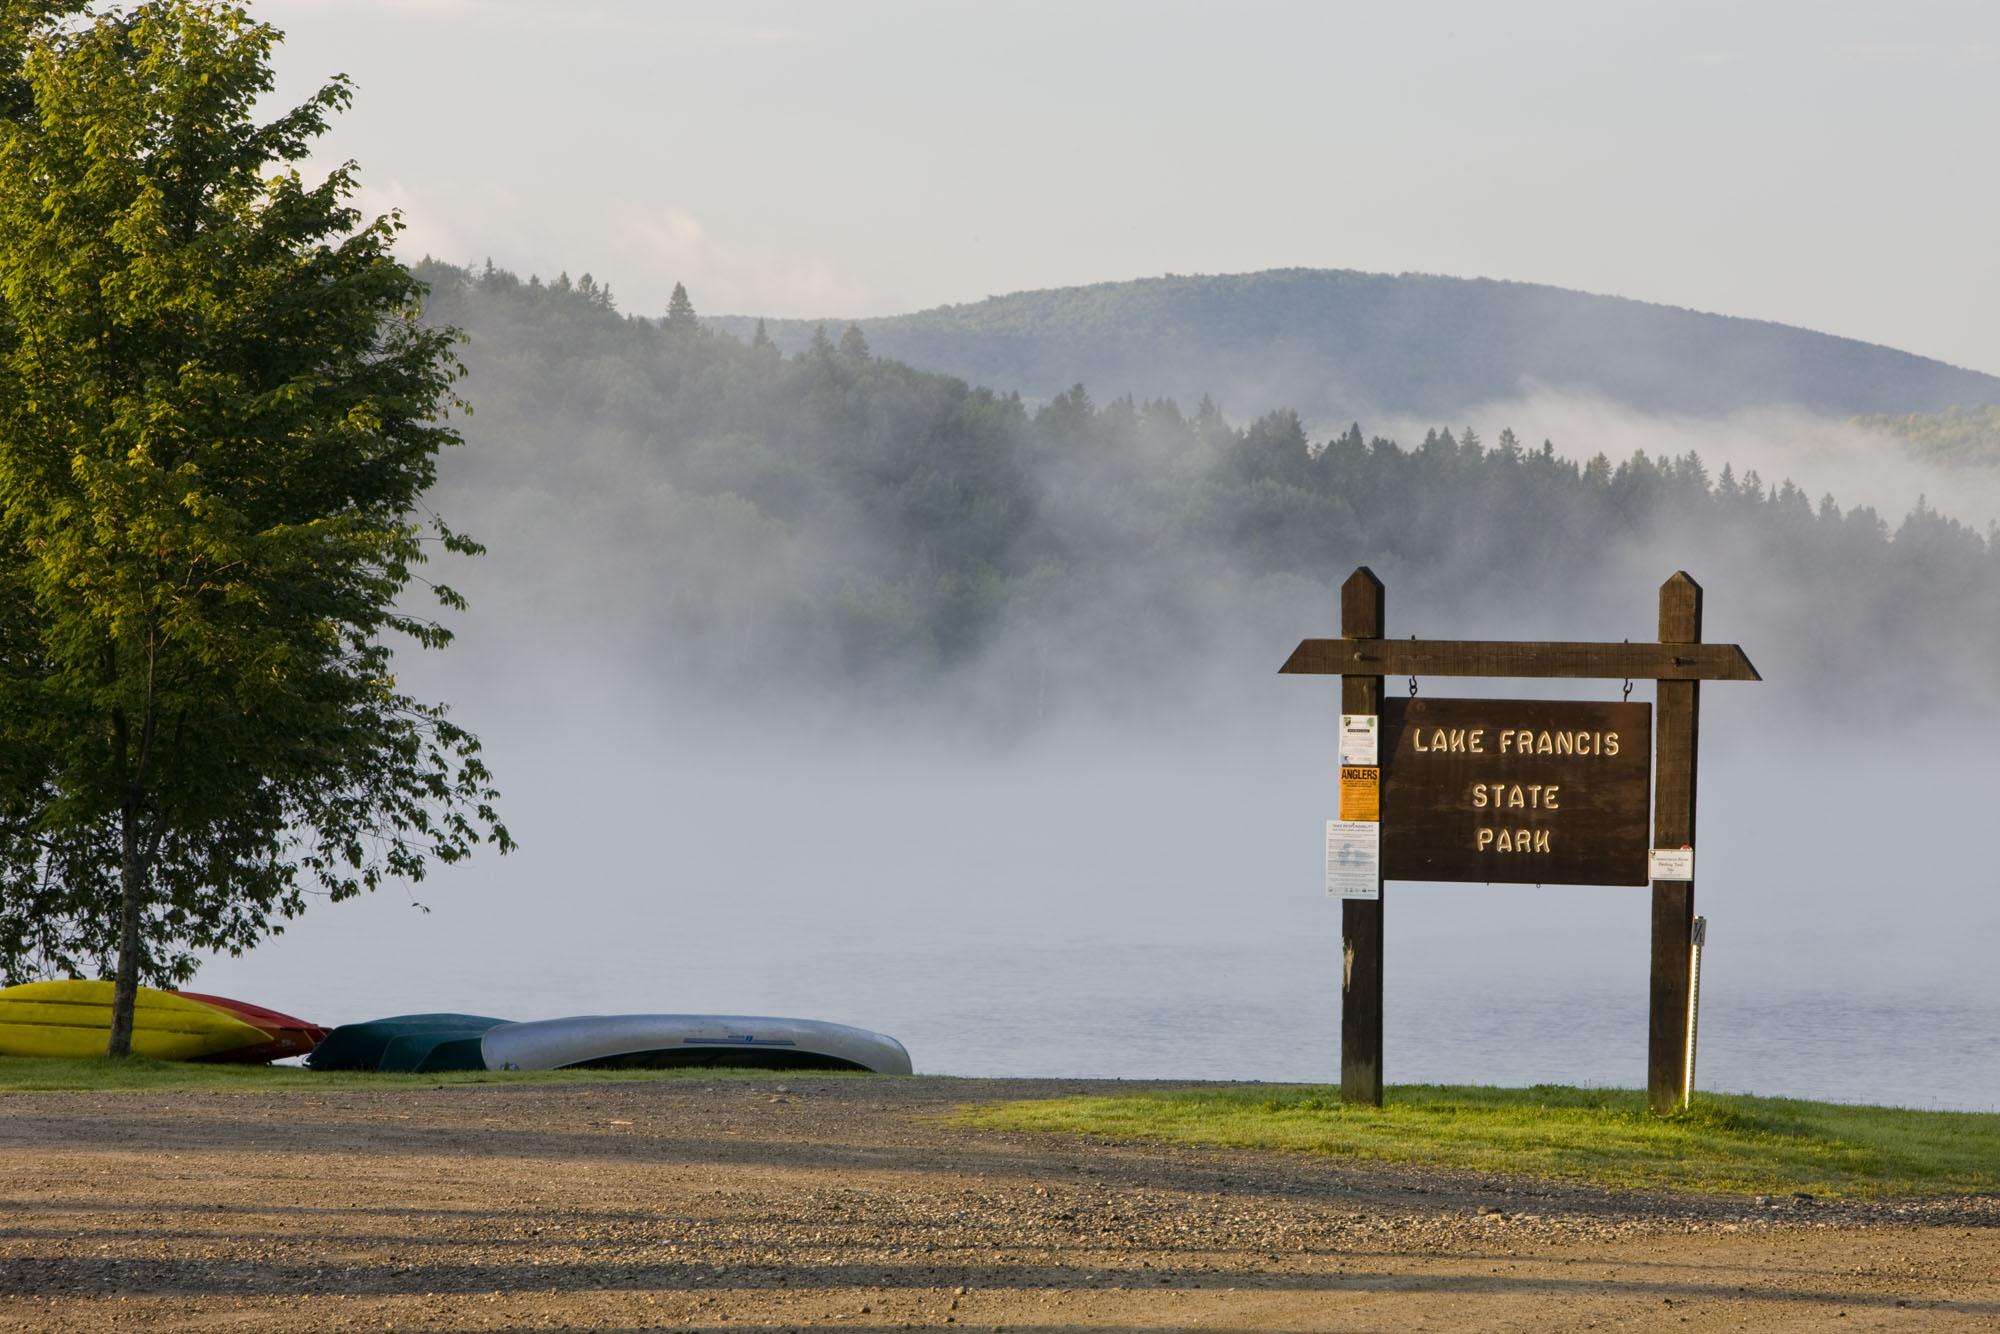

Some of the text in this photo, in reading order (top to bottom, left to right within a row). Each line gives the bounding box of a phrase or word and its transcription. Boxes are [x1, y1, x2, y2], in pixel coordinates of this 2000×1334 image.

[1413, 728, 1621, 757] LAKE FRANCIS
[1341, 769, 1378, 780] ANGLERS
[1472, 783, 1561, 810] STATE
[1476, 828, 1552, 854] PARK
